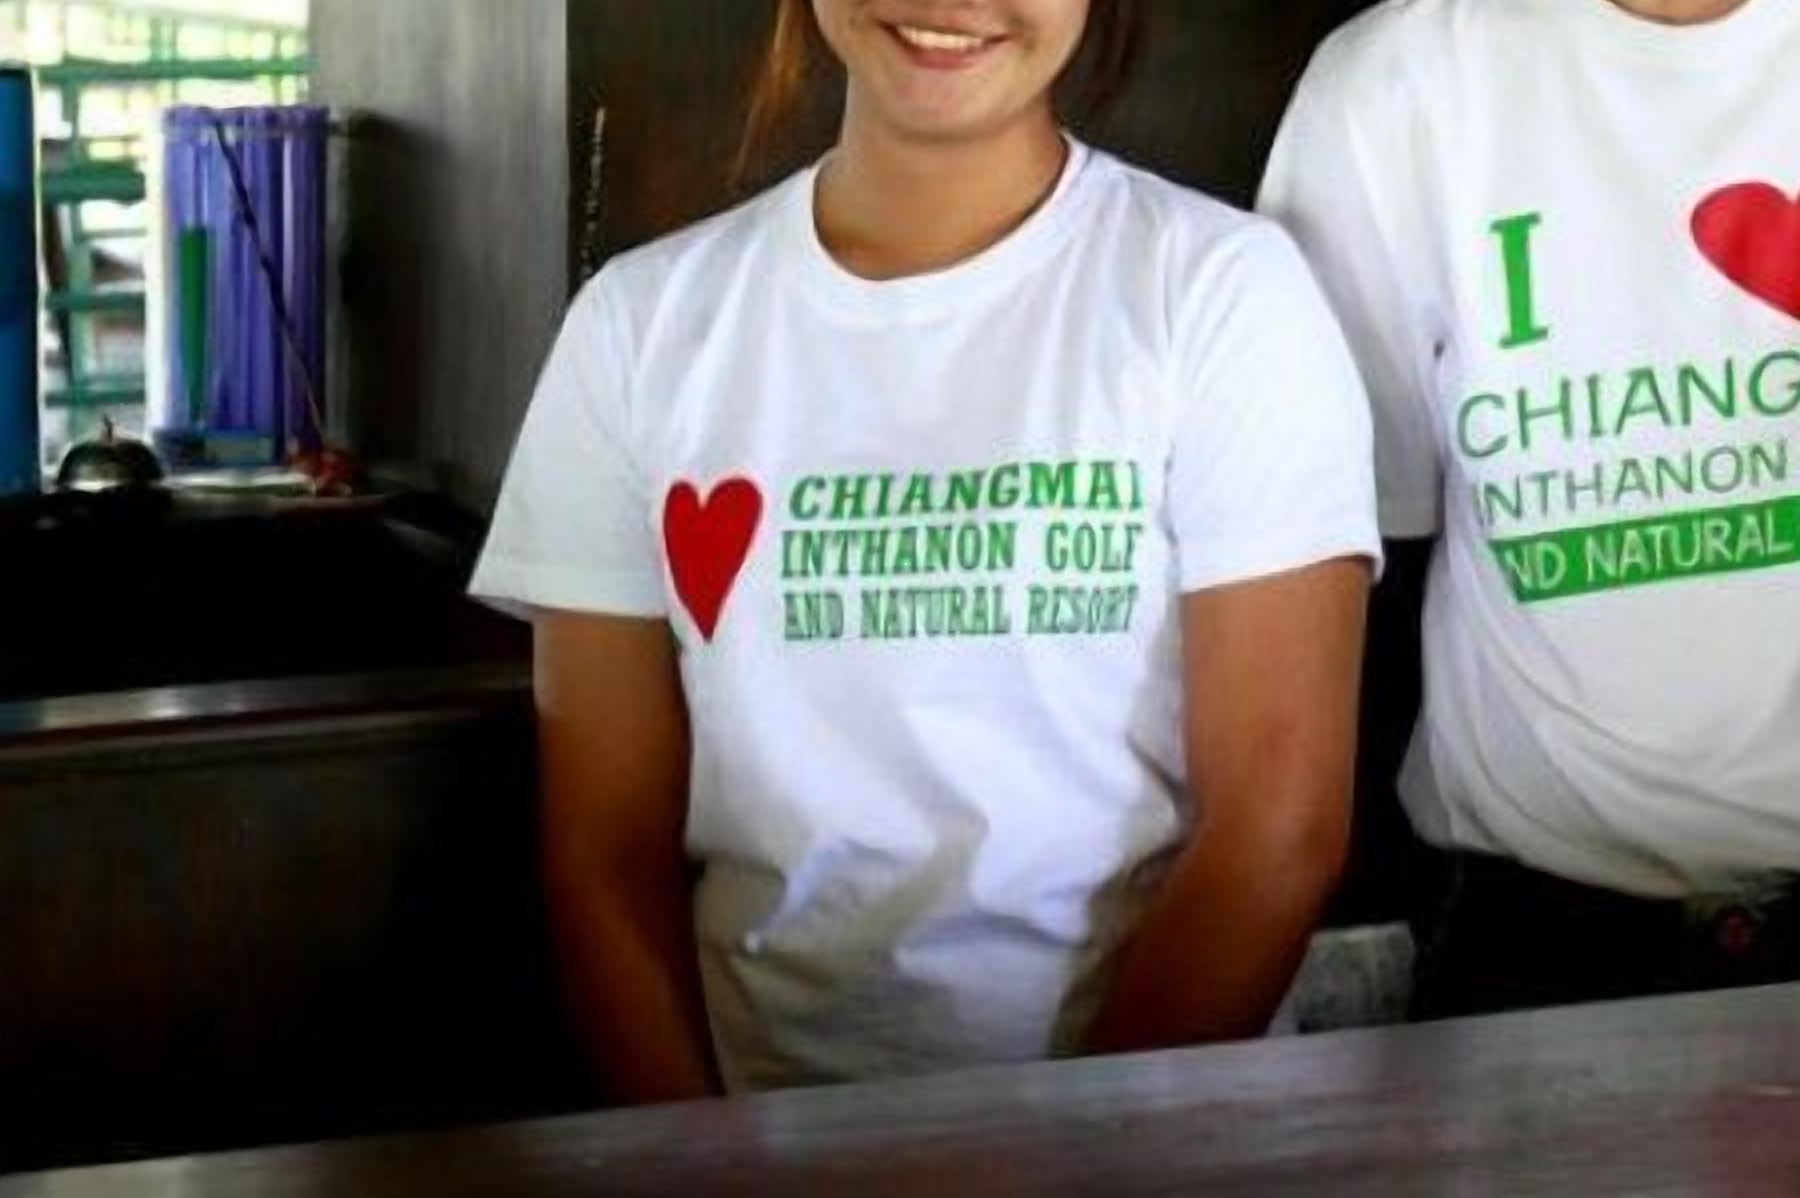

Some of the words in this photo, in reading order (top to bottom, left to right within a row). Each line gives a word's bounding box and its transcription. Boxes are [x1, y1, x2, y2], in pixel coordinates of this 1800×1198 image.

[1490, 212, 1548, 349] I
[789, 461, 1144, 521] CHIANGMAI
[781, 520, 1016, 578] INTHANON
[1046, 520, 1144, 574] GOLF
[1503, 541, 1567, 590] ND
[1584, 510, 1793, 584] NATURAL
[784, 592, 845, 642] AND
[860, 584, 1012, 640] NATURAL
[1027, 582, 1139, 636] RESORT
